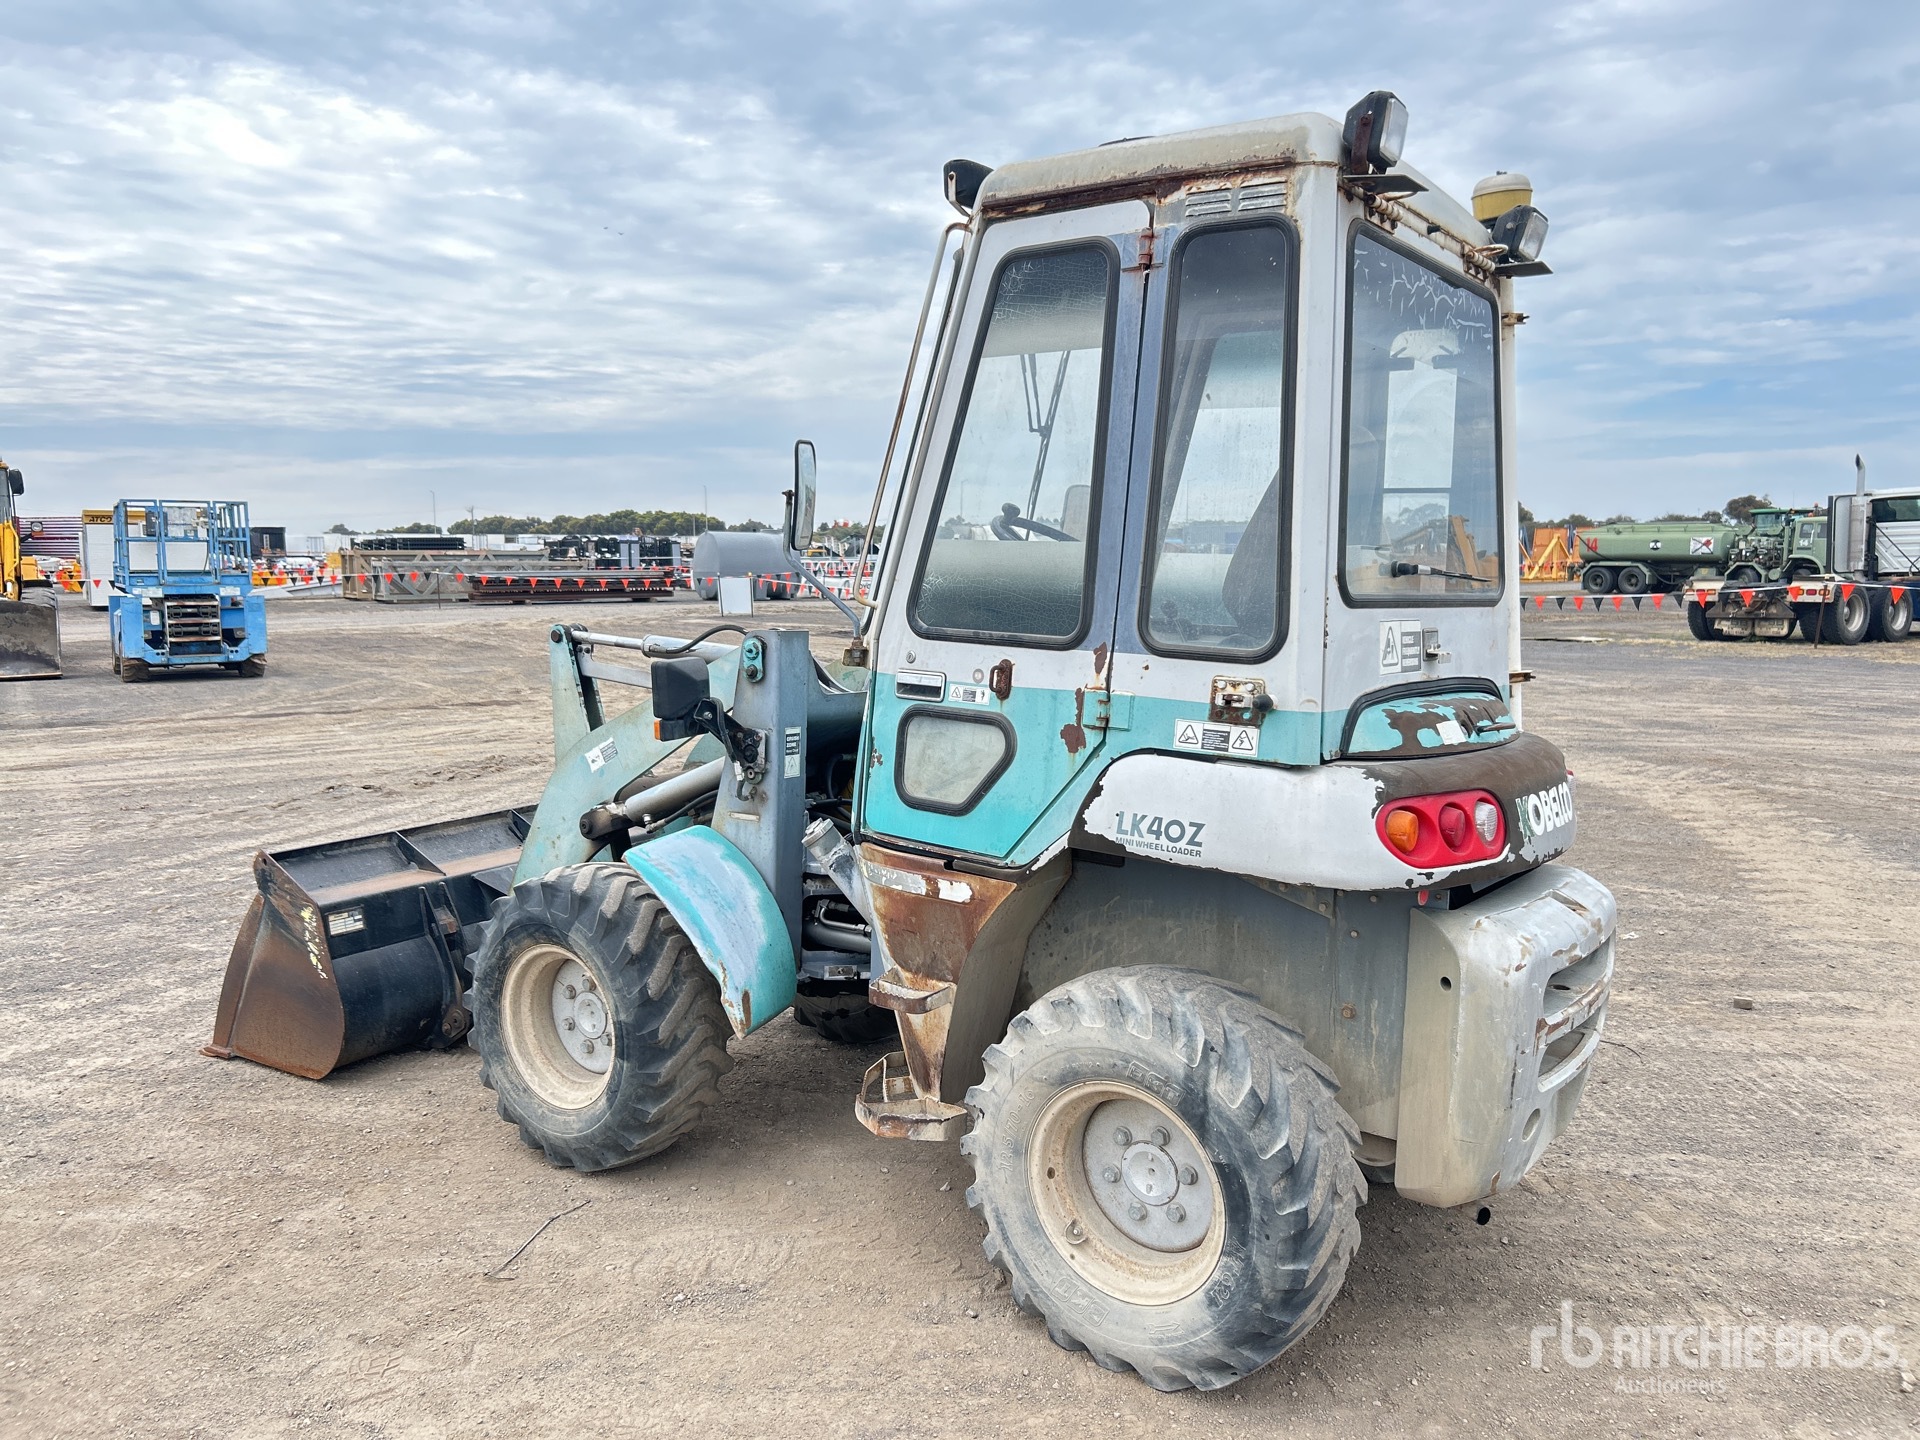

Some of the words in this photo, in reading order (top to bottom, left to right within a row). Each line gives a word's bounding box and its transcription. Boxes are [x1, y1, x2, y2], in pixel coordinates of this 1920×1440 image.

[1586, 537, 1598, 552] 14
[1115, 836, 1134, 847] MINI
[1135, 839, 1165, 852] WHEEL
[1166, 845, 1202, 858] LOADER
